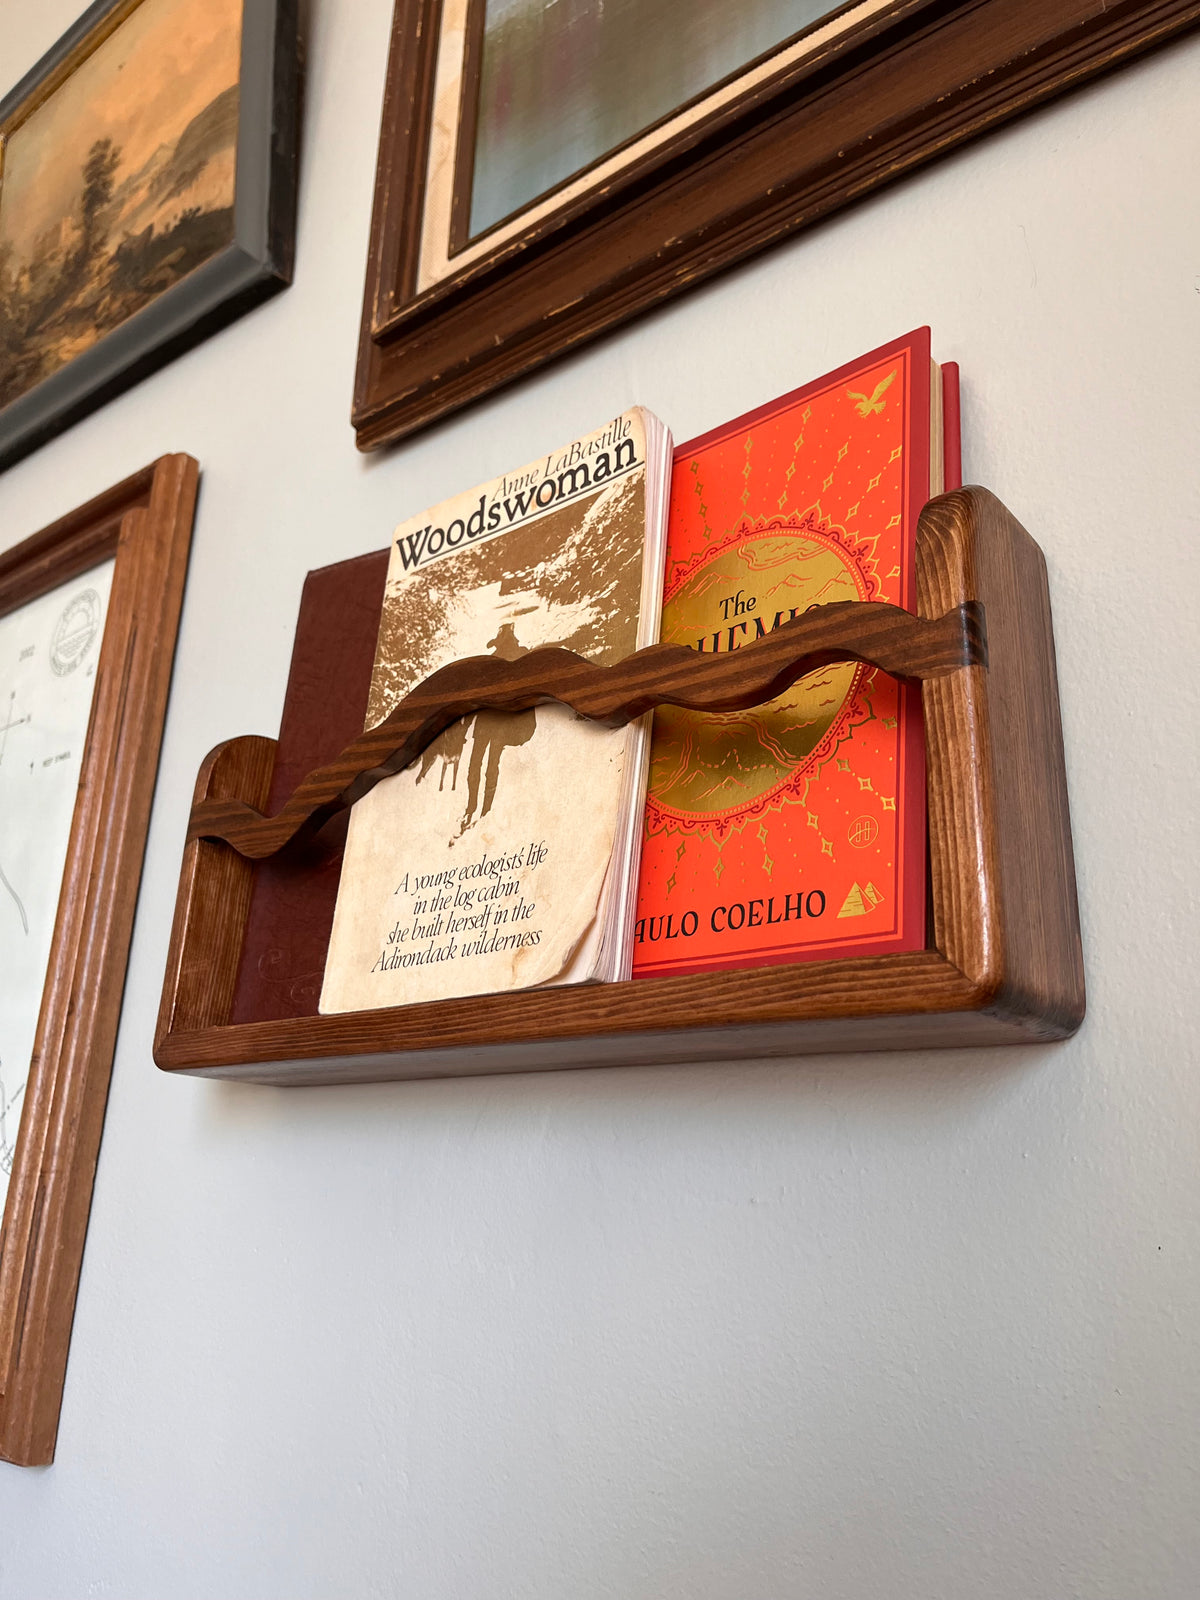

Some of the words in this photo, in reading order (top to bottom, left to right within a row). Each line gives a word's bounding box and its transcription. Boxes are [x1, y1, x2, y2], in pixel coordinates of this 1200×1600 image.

[491, 468, 538, 501] Anne
[544, 416, 632, 477] LaBastille
[396, 437, 638, 571] Woodswoman
[718, 589, 757, 621] The
[394, 872, 409, 895] A
[411, 867, 458, 896] young
[526, 840, 549, 871] life
[387, 921, 410, 945] she
[411, 914, 445, 940] built
[445, 903, 495, 935] herself
[494, 905, 508, 925] in
[511, 897, 536, 922] the
[413, 895, 427, 915] in
[430, 889, 452, 912] the
[454, 885, 477, 911] log
[477, 876, 520, 903] cabin
[634, 911, 699, 944] AULO
[710, 889, 826, 933] COELHO
[371, 937, 457, 973] Adirondack
[461, 928, 543, 958] wilderness
